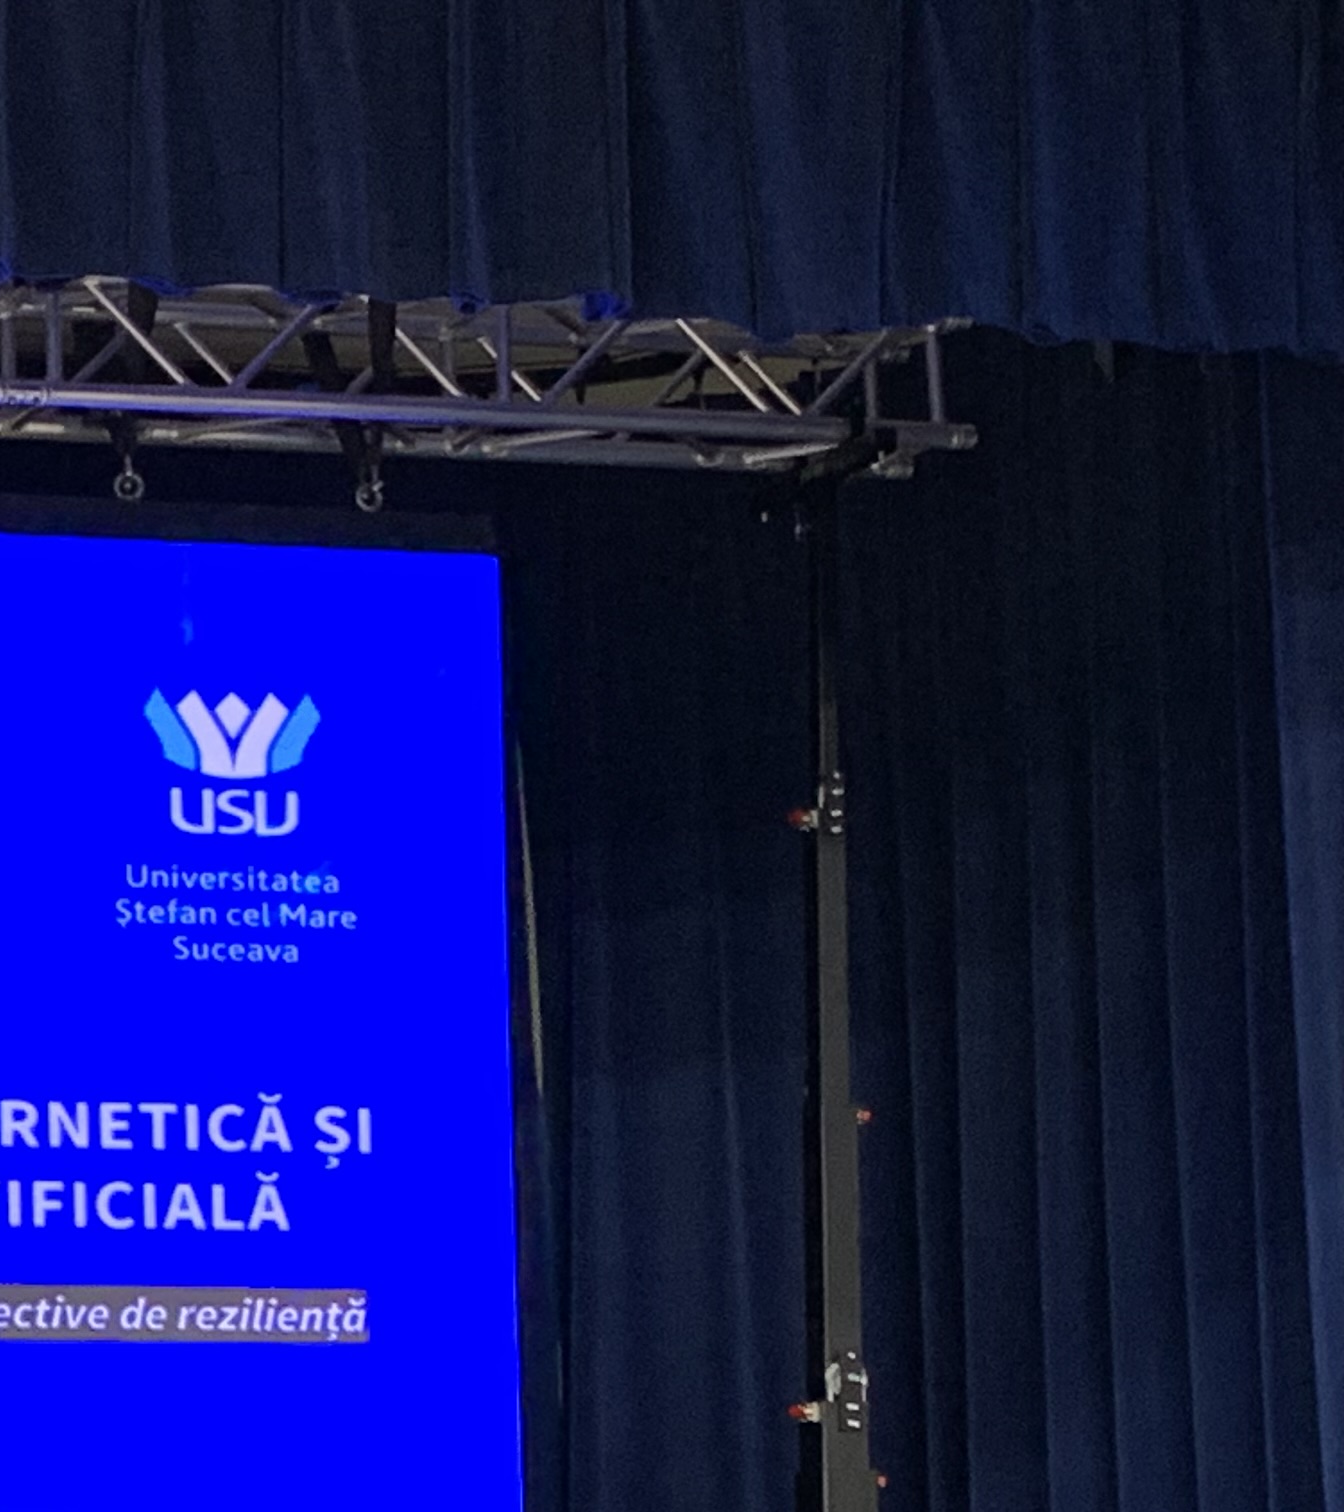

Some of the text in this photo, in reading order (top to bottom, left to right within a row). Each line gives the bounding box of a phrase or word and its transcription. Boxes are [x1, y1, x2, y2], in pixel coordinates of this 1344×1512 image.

[126, 863, 340, 893] Universitatea
[226, 902, 271, 928] cel
[279, 903, 358, 929] Mare
[172, 935, 300, 963] Suceava
[314, 1105, 372, 1169] ȘI
[119, 1297, 167, 1331] de
